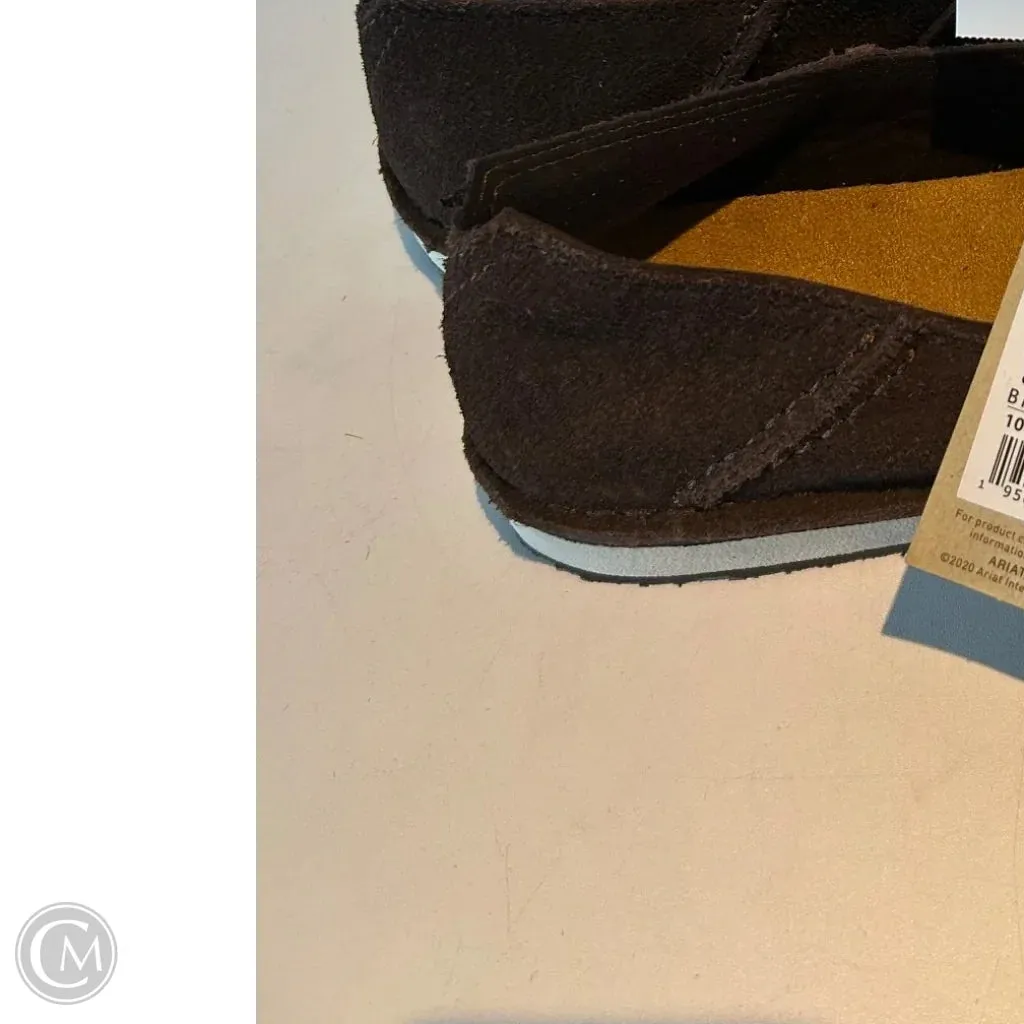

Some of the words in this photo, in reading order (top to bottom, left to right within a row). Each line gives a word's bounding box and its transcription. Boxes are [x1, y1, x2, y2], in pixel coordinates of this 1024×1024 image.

[1007, 387, 1020, 404] B
[977, 479, 985, 490] 1
[955, 507, 973, 525] For
[974, 518, 1017, 540] product
[940, 552, 975, 573] ©2020
[975, 567, 1003, 584] Ariat
